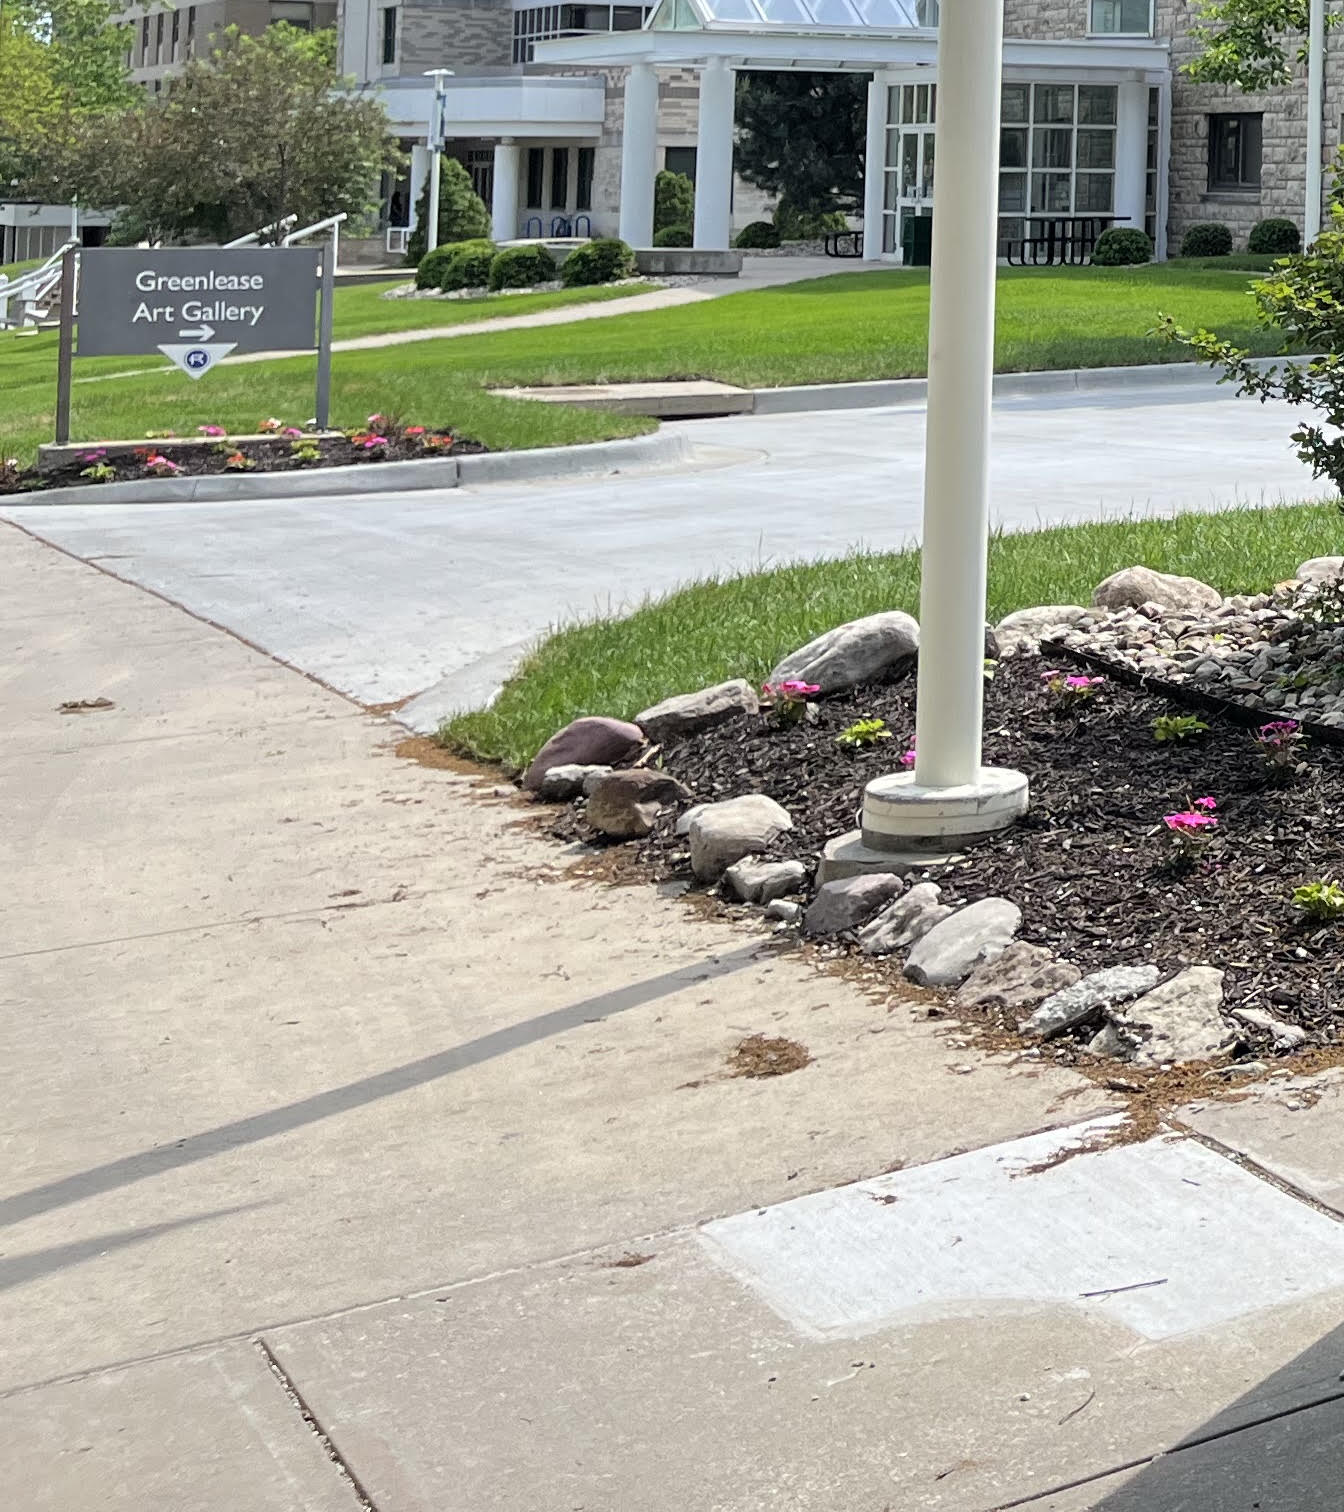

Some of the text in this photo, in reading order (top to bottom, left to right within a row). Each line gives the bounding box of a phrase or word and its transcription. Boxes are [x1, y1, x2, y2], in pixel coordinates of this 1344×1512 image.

[135, 270, 264, 292] Greenlease
[132, 300, 264, 326] Art Gallery
